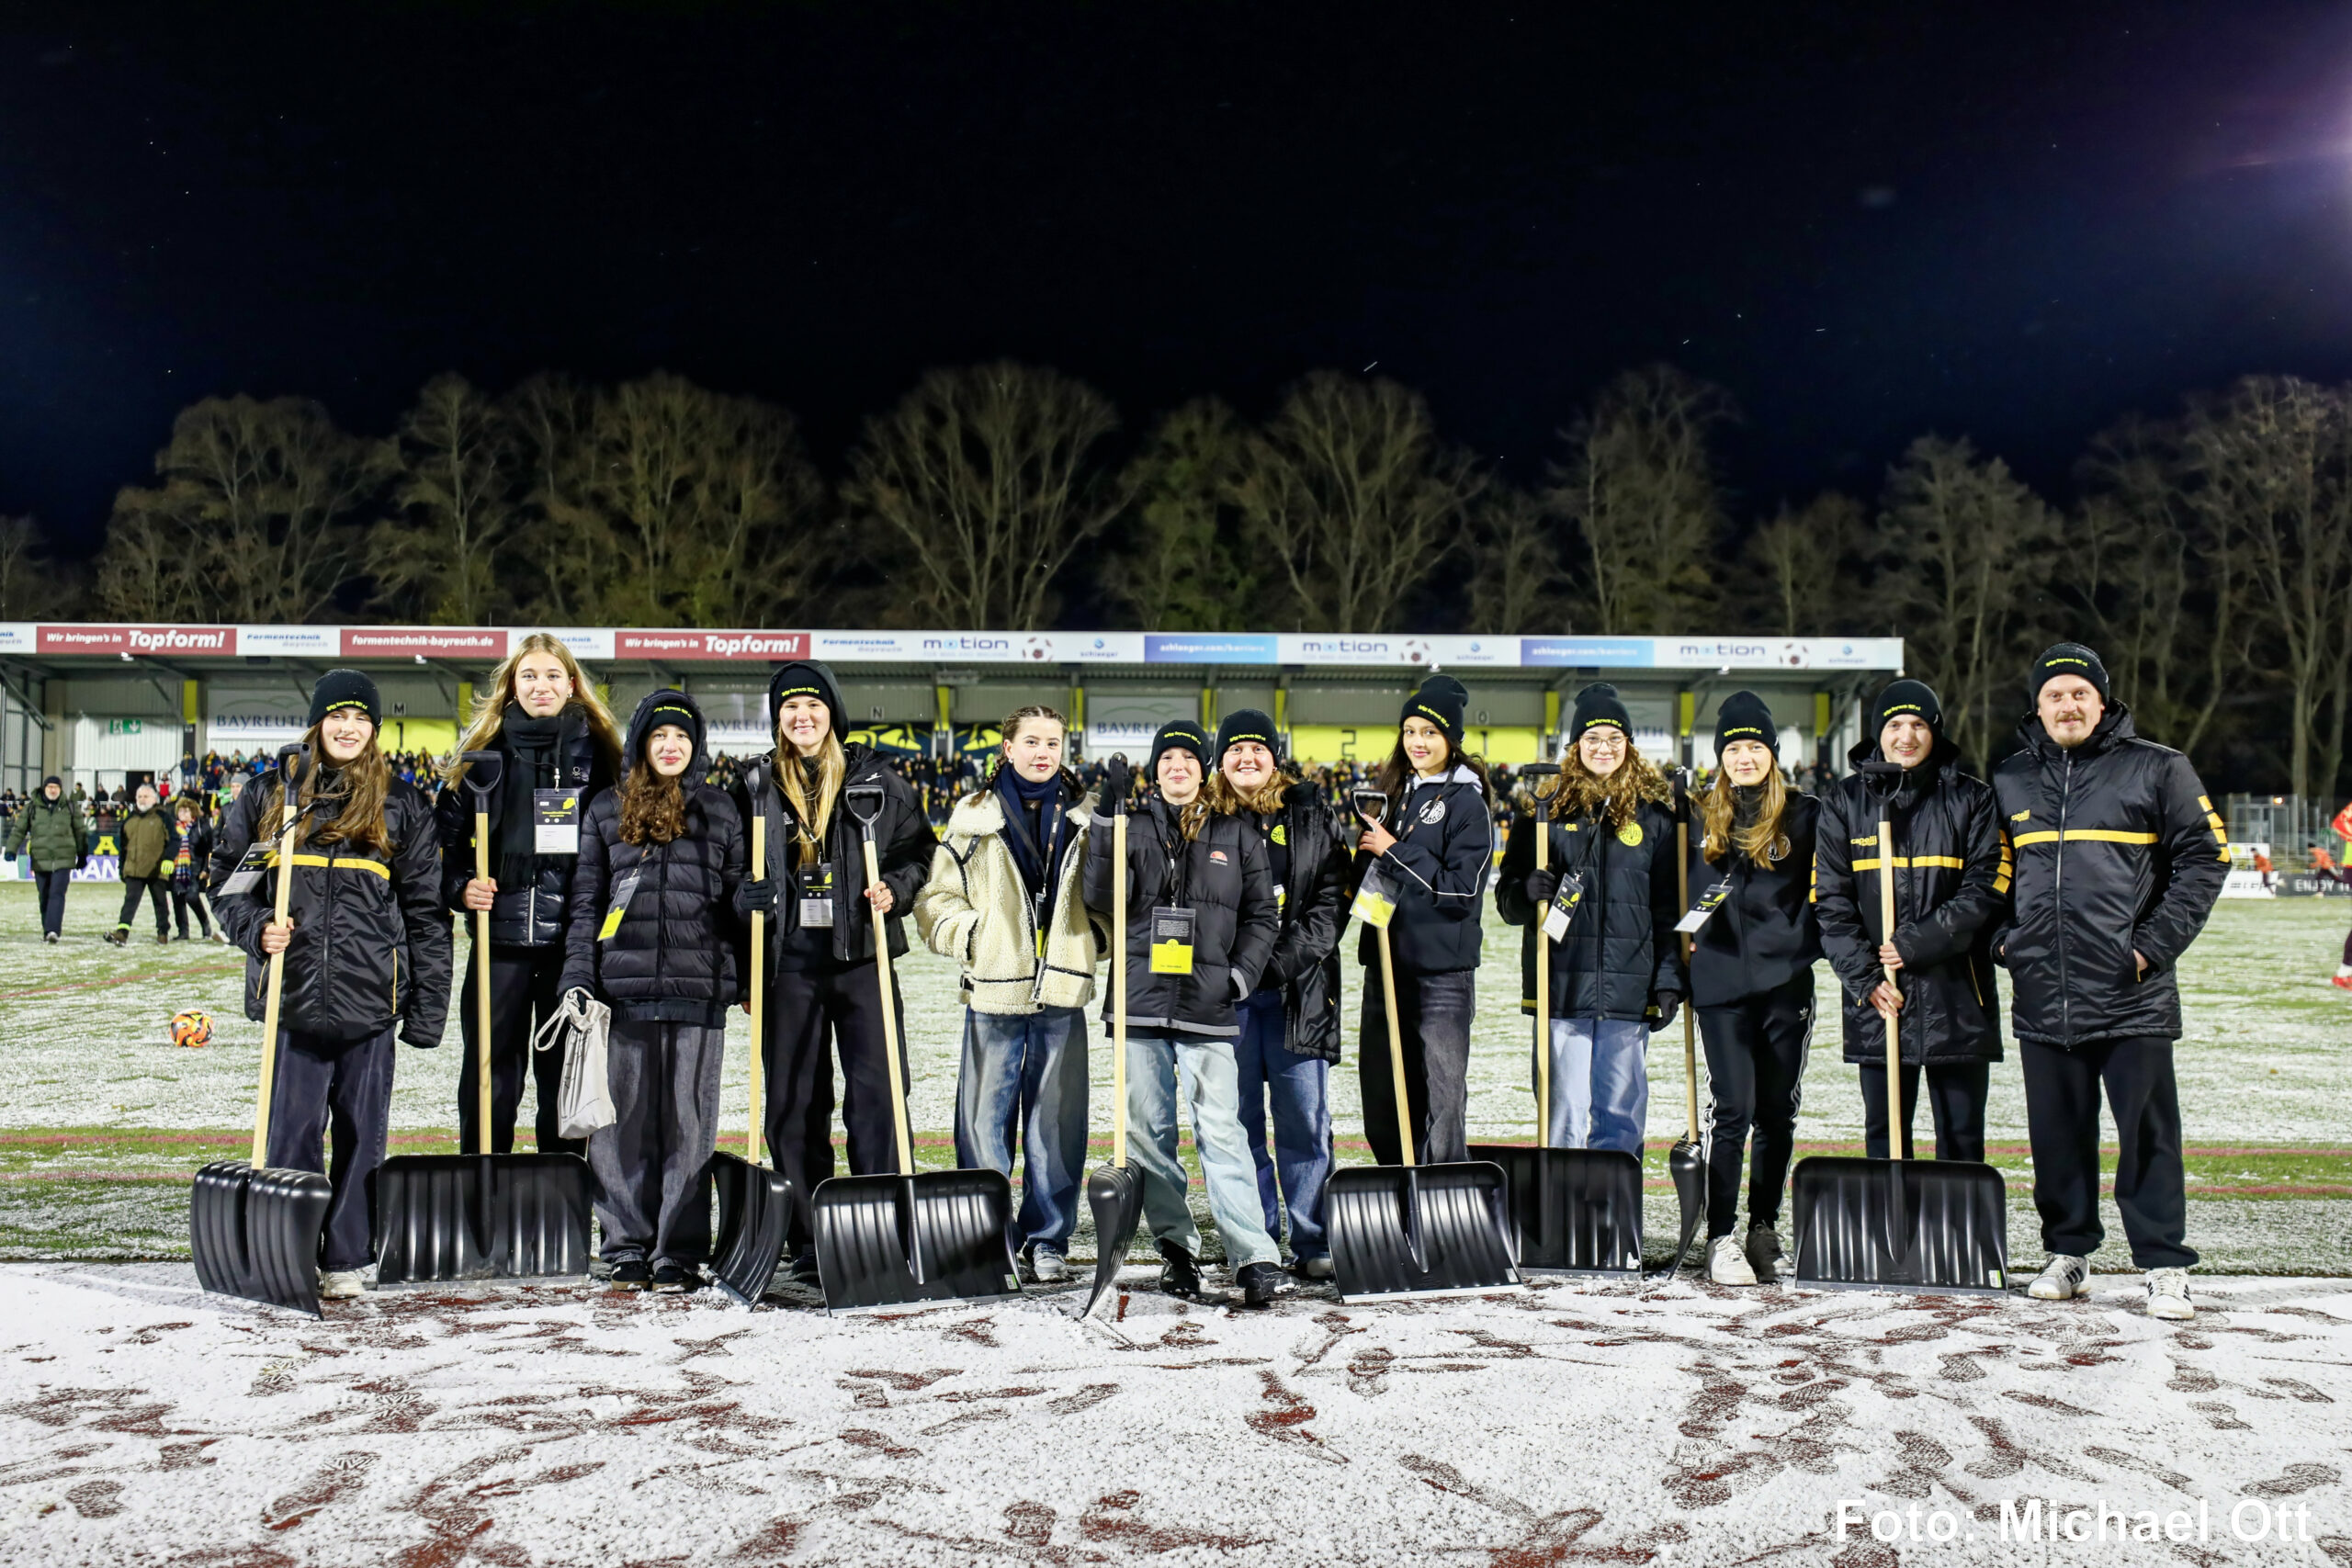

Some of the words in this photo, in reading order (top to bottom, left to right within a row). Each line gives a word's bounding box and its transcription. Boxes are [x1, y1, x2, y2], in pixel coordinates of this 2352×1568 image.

[46, 632, 63, 643] Wir
[65, 632, 109, 645] bringen's
[112, 633, 122, 643] in
[129, 629, 225, 651] Topform!
[625, 637, 642, 648] Wir
[643, 637, 687, 649] bringen's
[689, 638, 699, 648] in
[705, 635, 800, 657] Topform!
[923, 637, 1009, 649] motion
[1303, 640, 1388, 652] motion
[1680, 643, 1766, 655] motion
[394, 704, 404, 714] M
[873, 708, 882, 717] N
